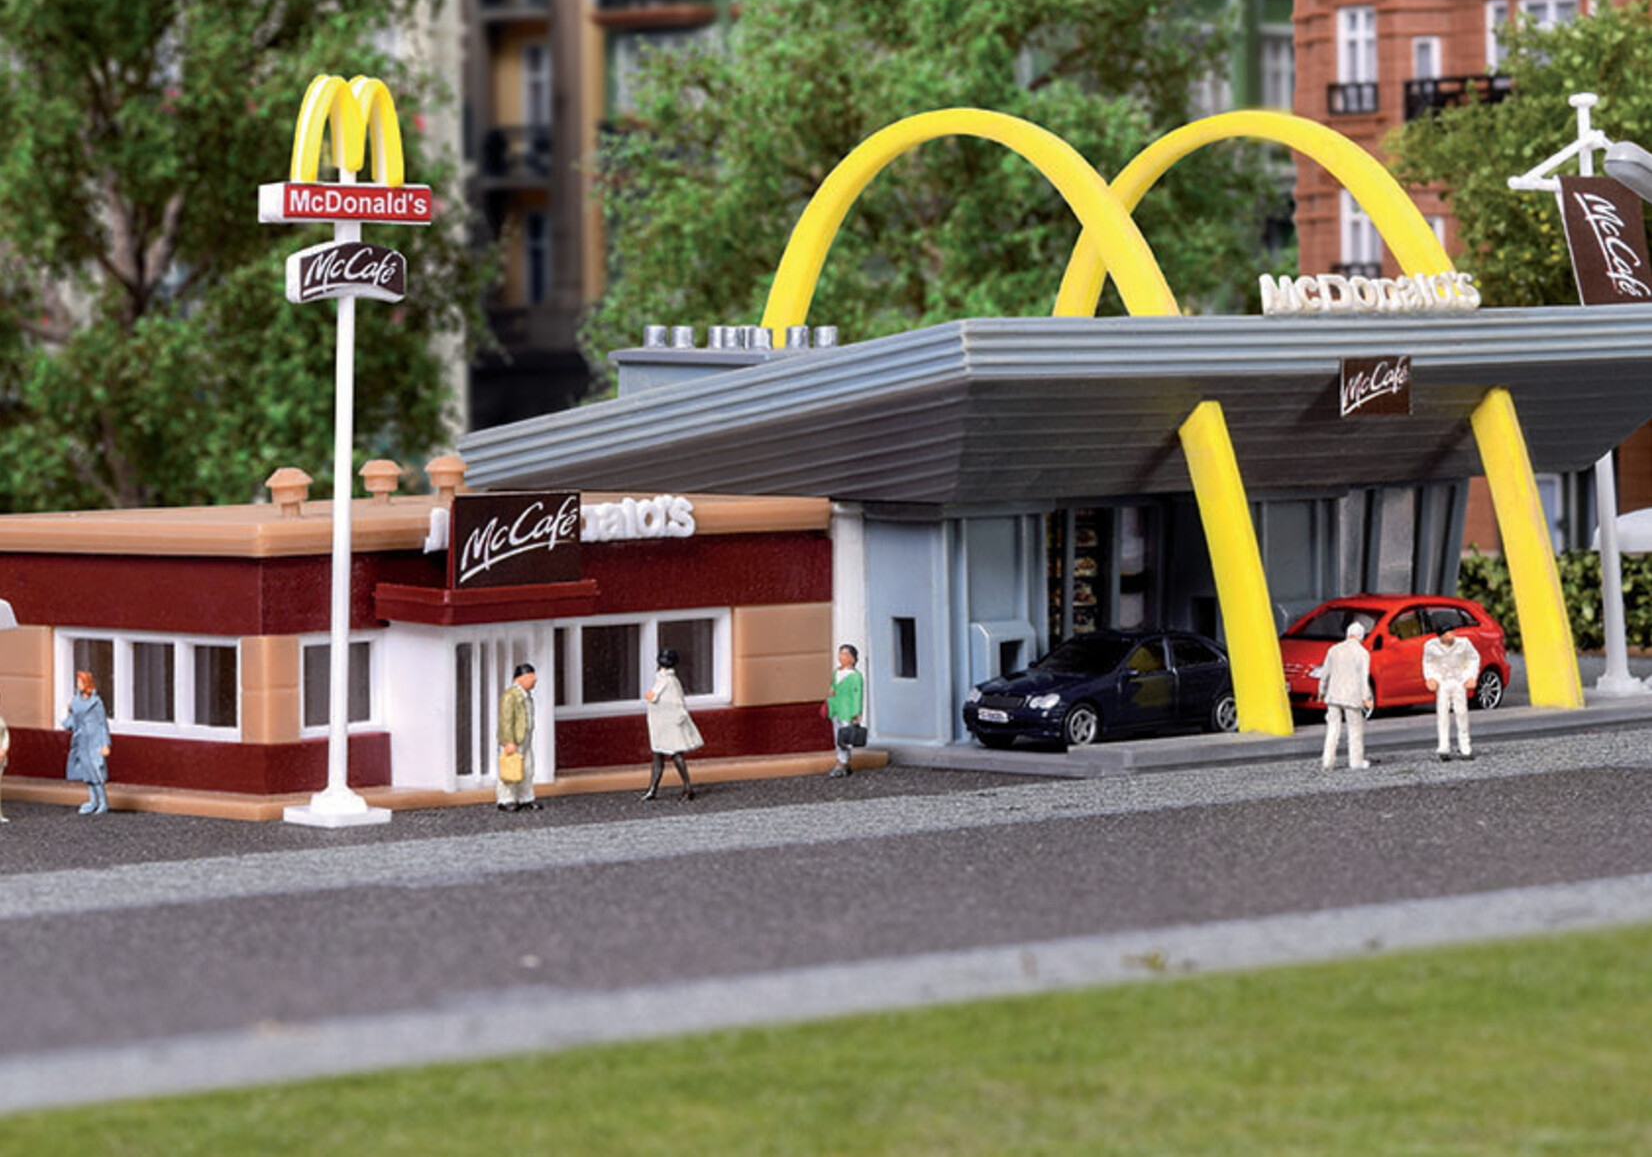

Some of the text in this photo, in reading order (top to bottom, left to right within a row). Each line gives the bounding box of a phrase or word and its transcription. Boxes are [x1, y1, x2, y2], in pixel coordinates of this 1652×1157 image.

[289, 189, 427, 214] McDonald's
[304, 246, 397, 287] McCafé
[1341, 356, 1408, 408] McCafé
[460, 496, 578, 571] McCafé
